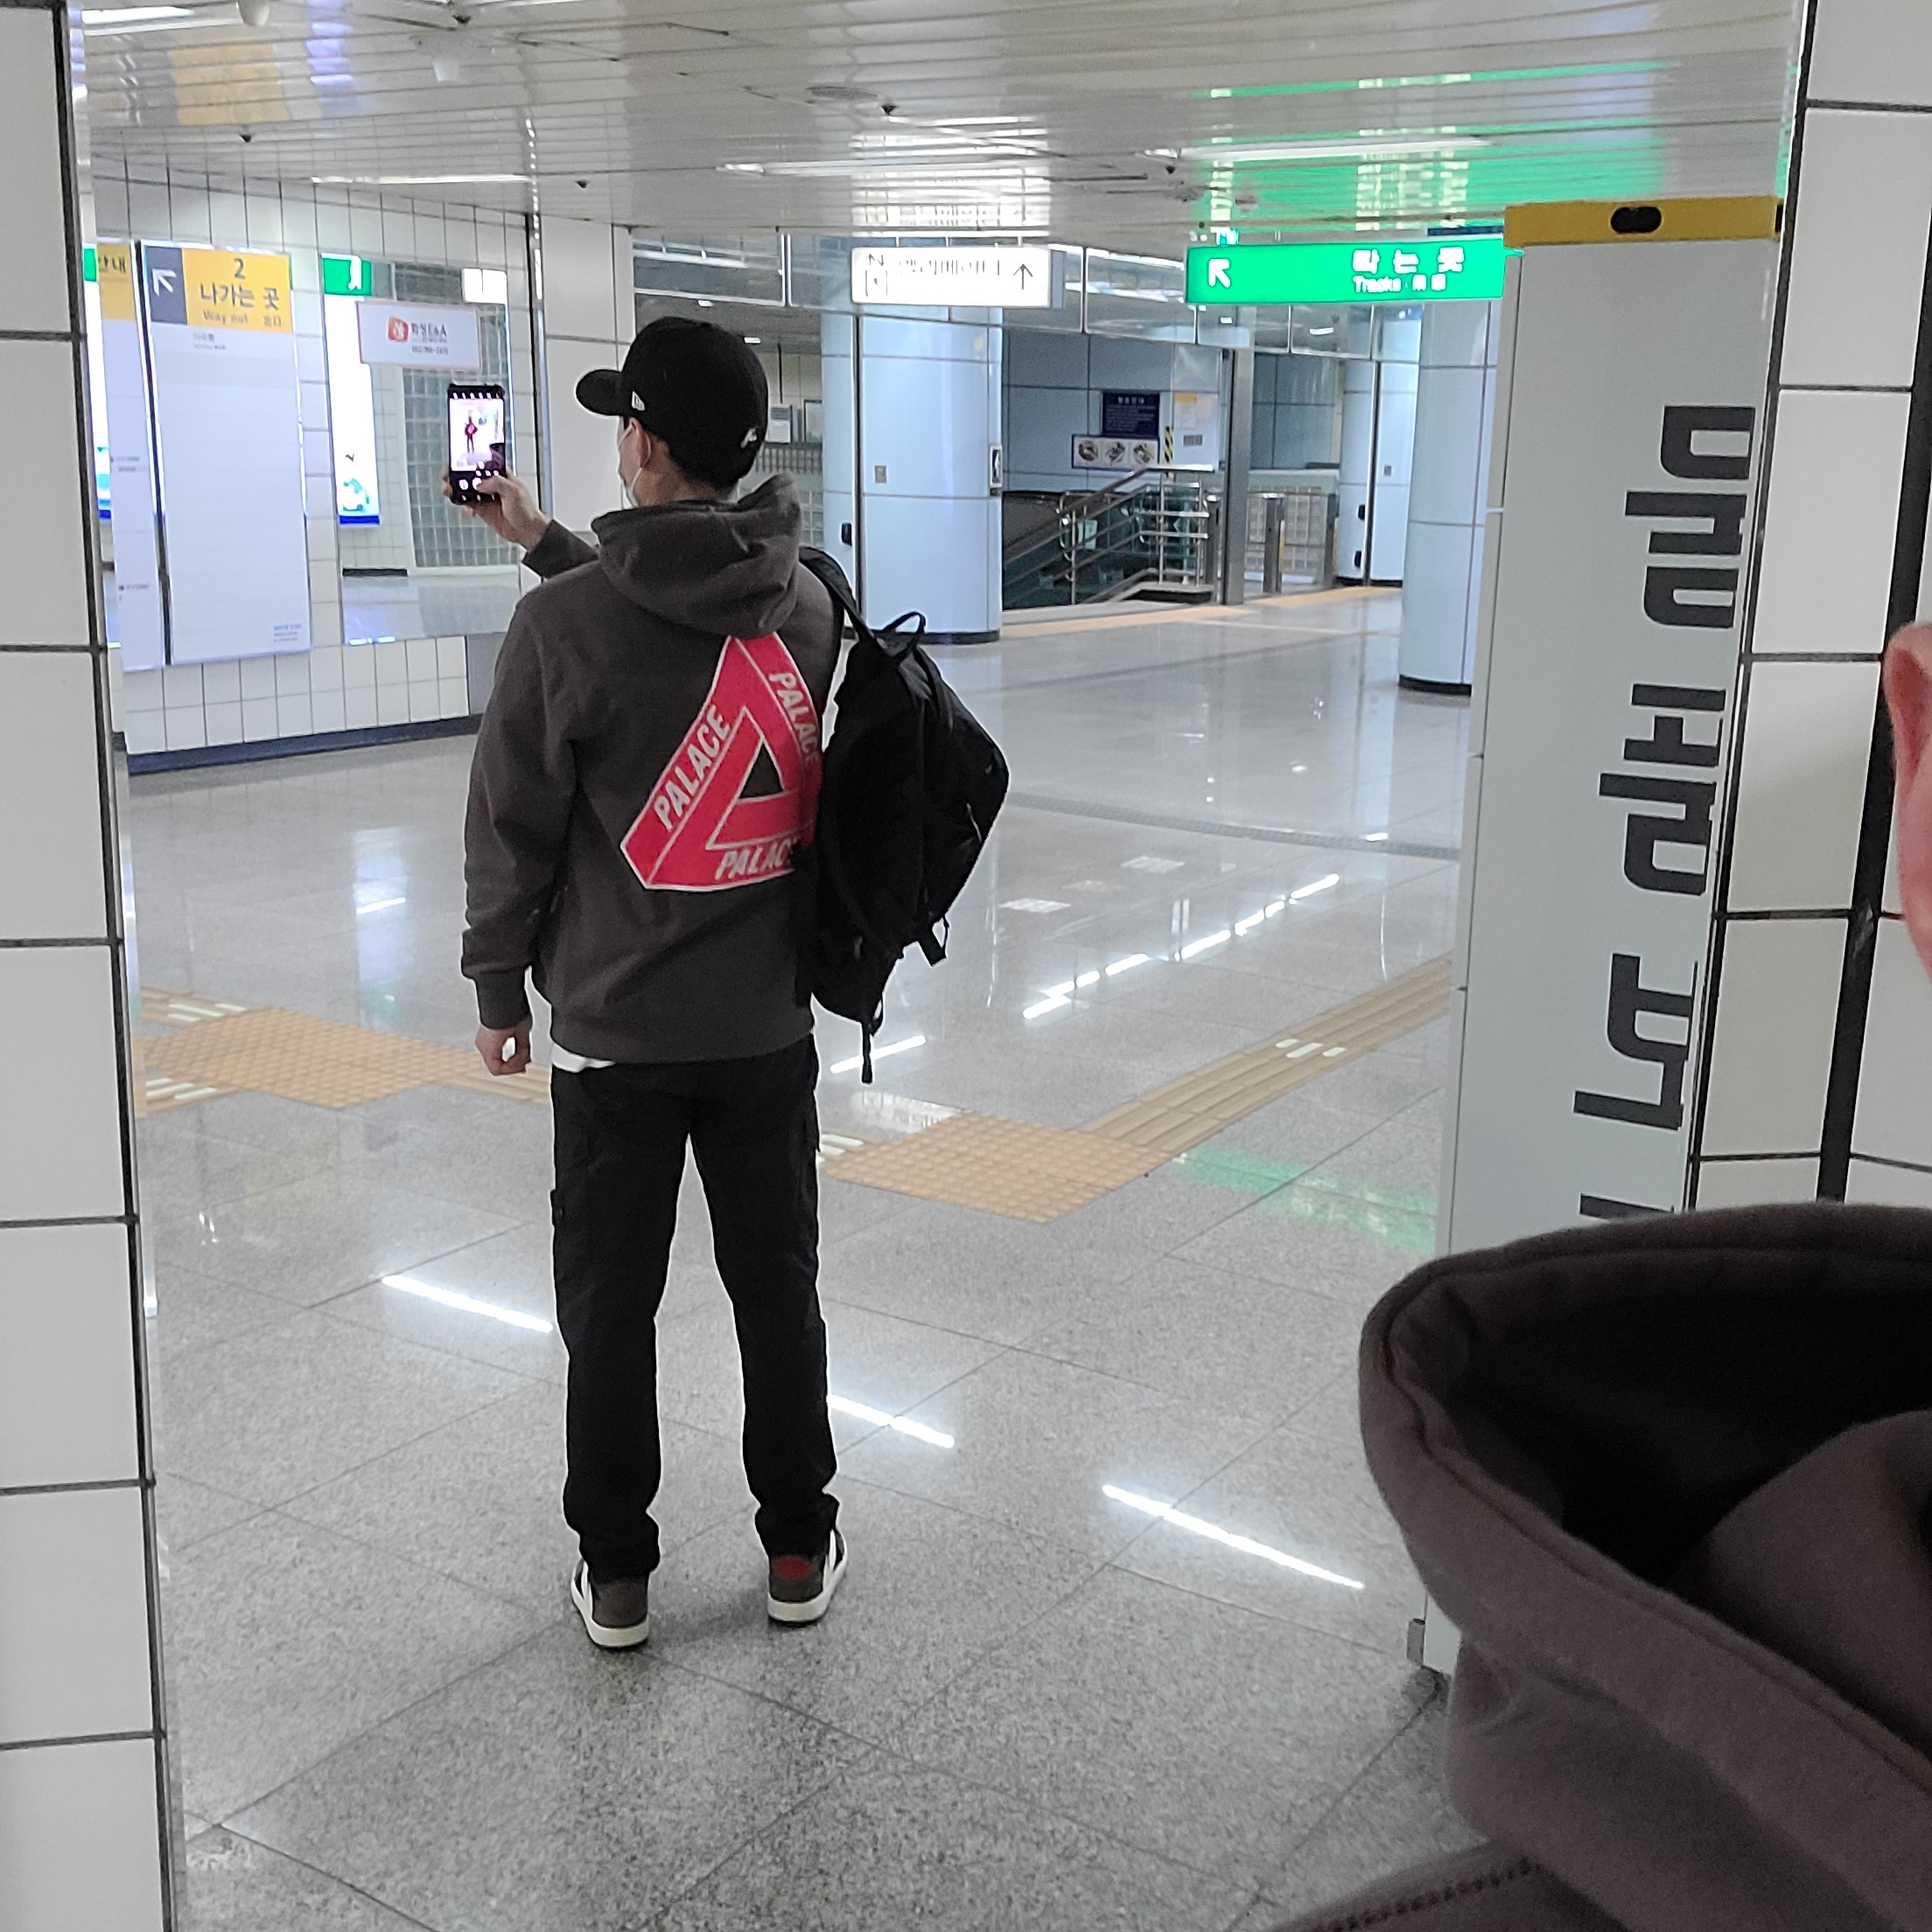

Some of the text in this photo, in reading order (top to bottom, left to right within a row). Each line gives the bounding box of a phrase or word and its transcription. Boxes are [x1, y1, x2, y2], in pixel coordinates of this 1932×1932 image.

[234, 257, 247, 280] 2
[200, 282, 280, 312] 나가는 곳
[203, 310, 227, 326] Way
[768, 672, 821, 766] PALACE
[654, 704, 730, 830] PALACE
